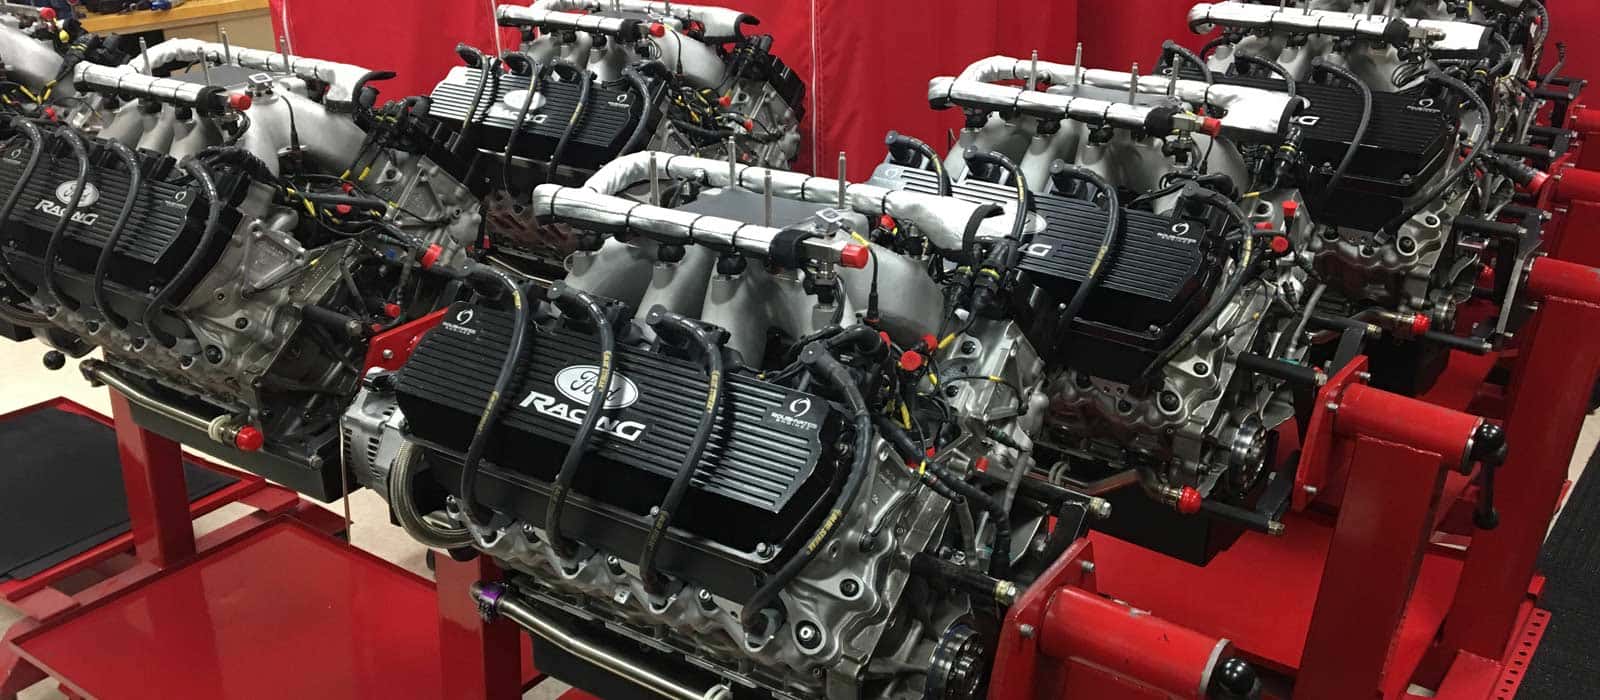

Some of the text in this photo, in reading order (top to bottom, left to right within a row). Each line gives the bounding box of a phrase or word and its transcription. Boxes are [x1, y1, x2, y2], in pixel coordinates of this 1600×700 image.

[34, 199, 99, 226] RACNG
[570, 370, 621, 402] Fod
[518, 390, 647, 442] RACNG
